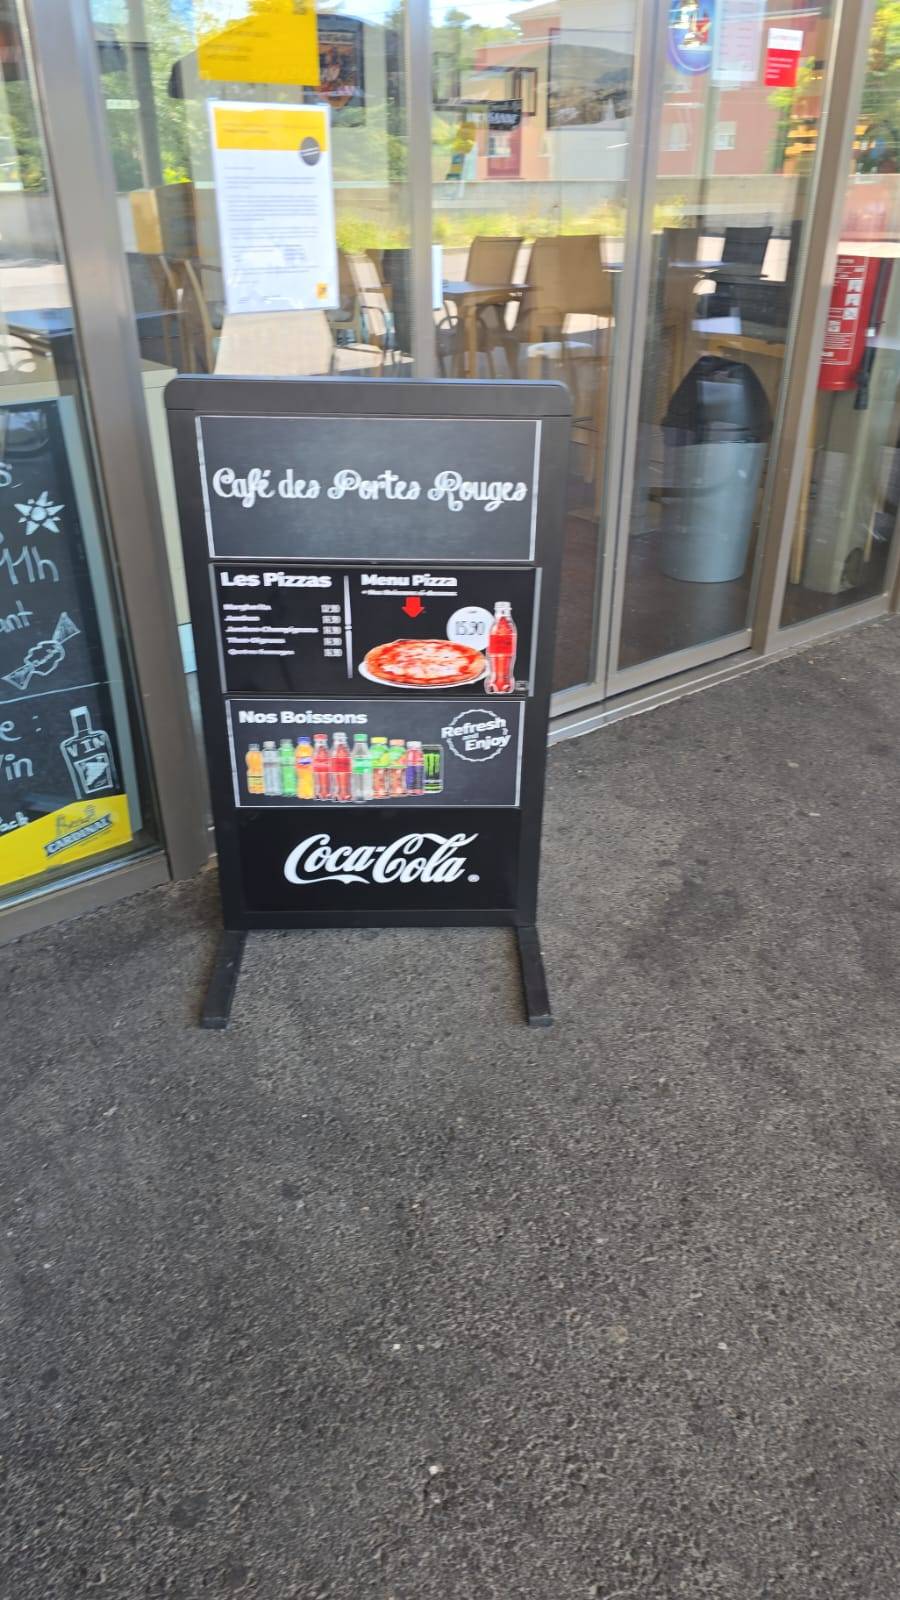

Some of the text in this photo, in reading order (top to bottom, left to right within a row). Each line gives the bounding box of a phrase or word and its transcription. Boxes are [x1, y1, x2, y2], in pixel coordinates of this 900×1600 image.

[212, 467, 528, 511] Café des Portes Rouges
[220, 571, 333, 588] Les Pizzas
[360, 573, 458, 588] Menu Pizza
[238, 710, 368, 725] Nos Boissons
[440, 716, 507, 739] Refresh
[464, 734, 512, 752] Enjoy
[284, 832, 479, 885] Coca-Cola
